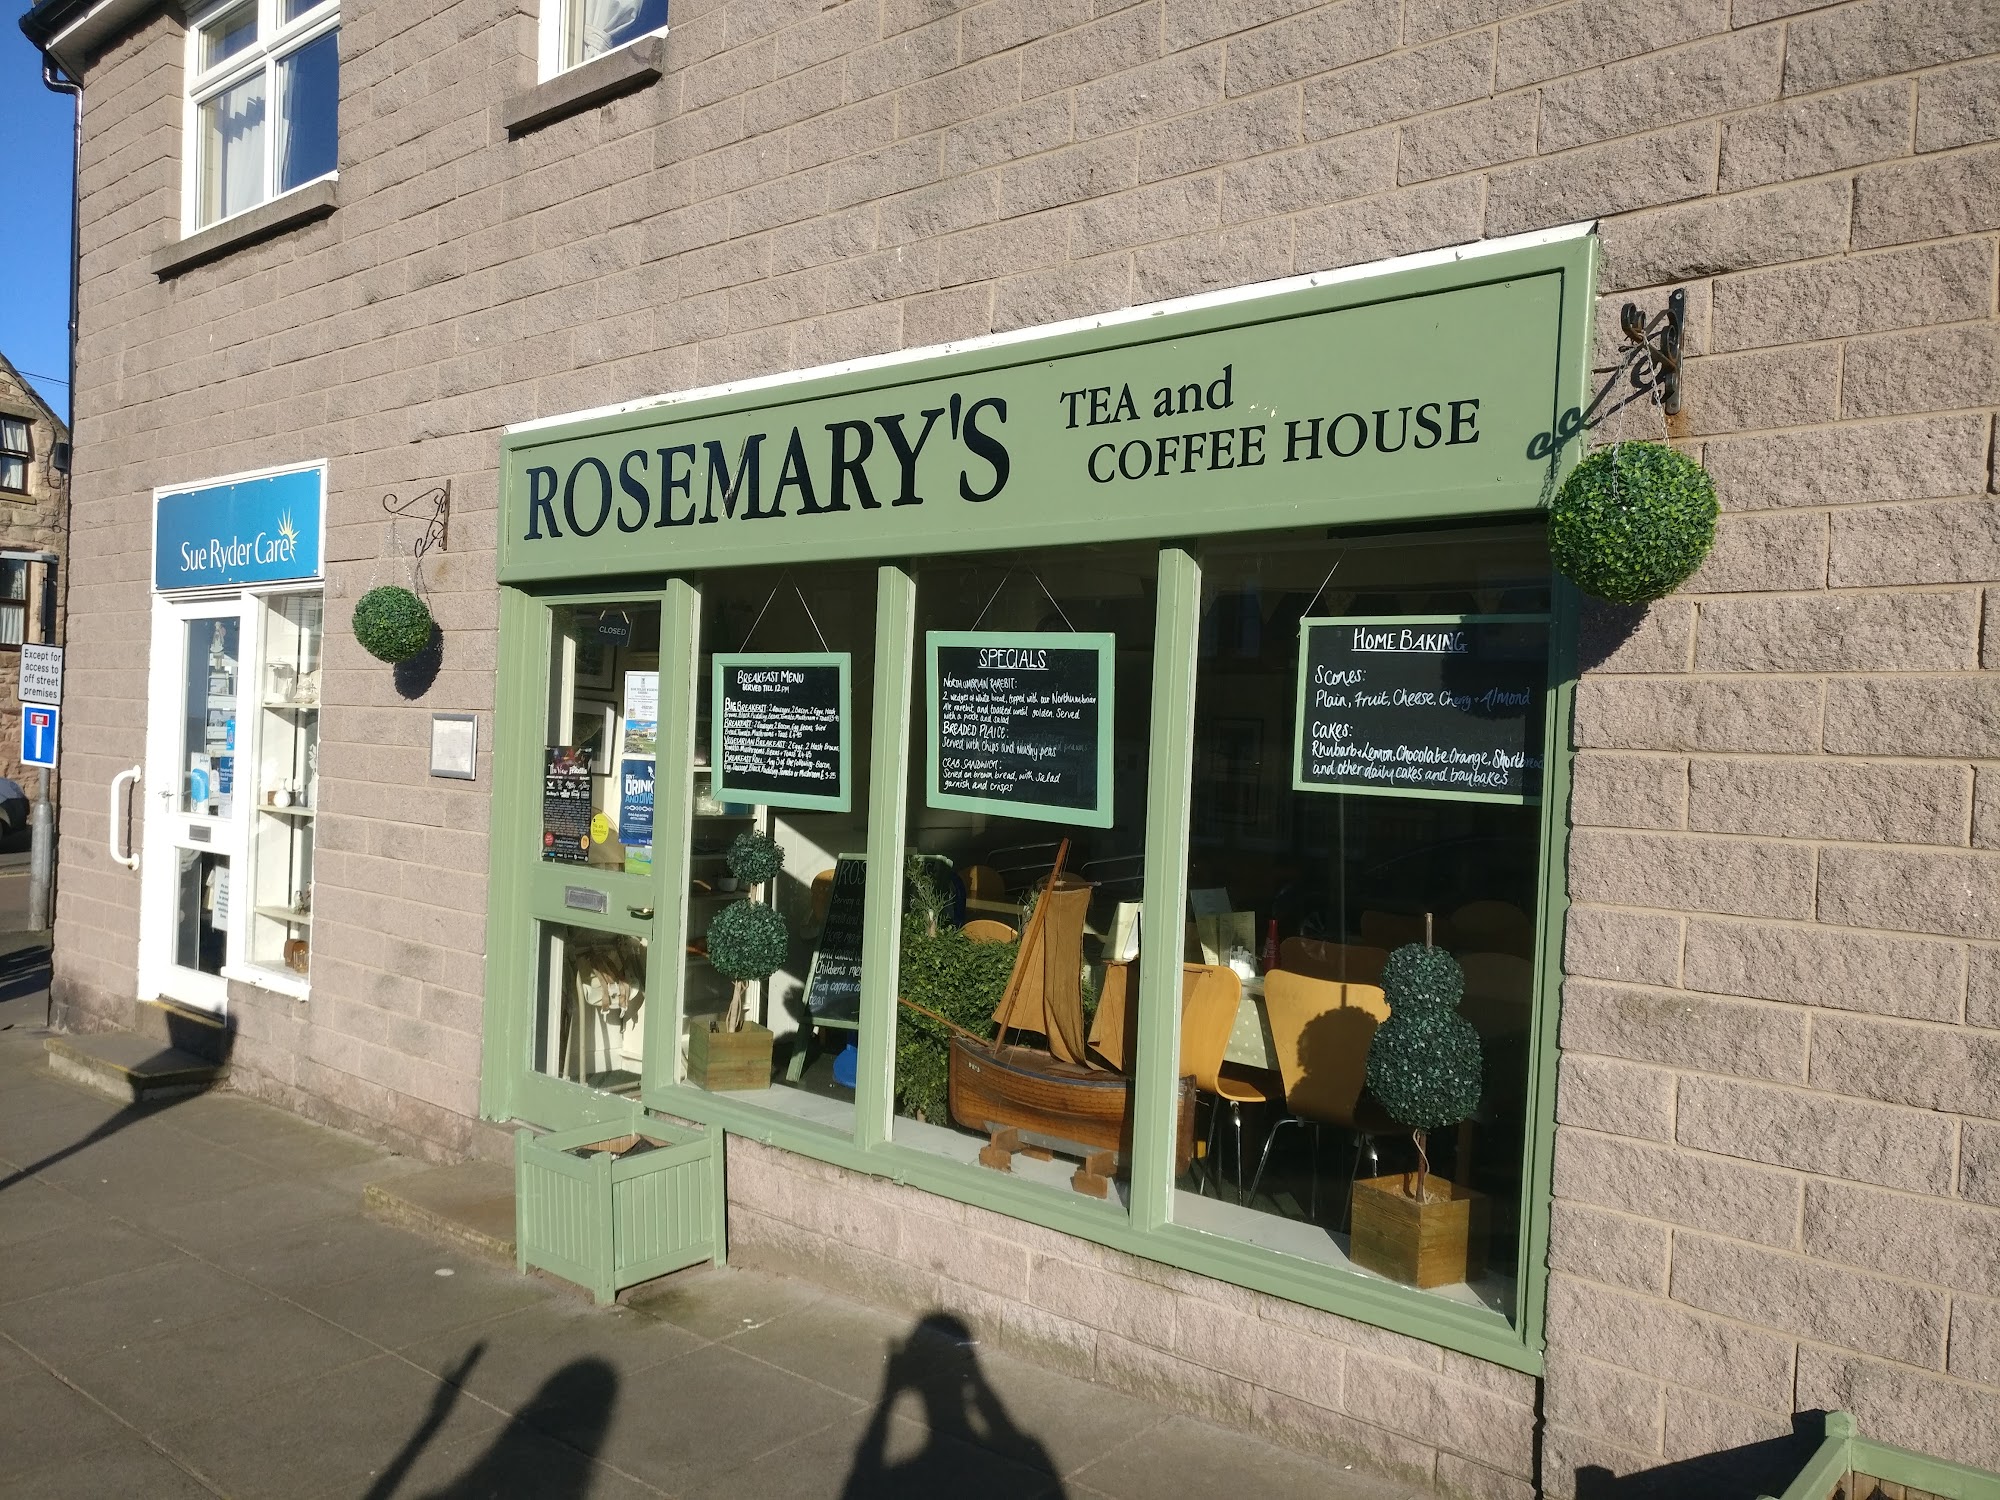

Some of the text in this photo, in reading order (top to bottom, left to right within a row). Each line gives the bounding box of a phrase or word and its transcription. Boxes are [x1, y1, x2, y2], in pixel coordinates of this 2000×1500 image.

[1059, 363, 1234, 429] TEA and
[1087, 398, 1481, 484] COFFEE HOUSE
[524, 392, 1010, 541] ROSEMARY'S
[180, 532, 290, 573] Sue Ryder Care
[598, 625, 627, 636] CLOSED
[1353, 626, 1467, 651] HOME BAKING
[24, 648, 61, 662] Except for
[978, 648, 1048, 668] SPECIALS
[25, 663, 59, 674] access to
[737, 670, 804, 684] BREAKFAST MENU
[1315, 664, 1366, 686] Scones:
[24, 673, 58, 687] off street
[24, 687, 58, 699] premises
[1315, 689, 1351, 708] Plain,
[976, 705, 989, 715] and
[942, 720, 977, 737] BREADED
[1312, 721, 1353, 741] Cakes:
[1312, 741, 1357, 758] Rhubarb
[1396, 745, 1447, 764] Chocolate
[1312, 760, 1335, 775] and
[1337, 762, 1362, 776] other
[1364, 764, 1395, 785] daily
[1395, 765, 1423, 782] cakes
[1425, 767, 1448, 783] and
[625, 779, 654, 796] DRINK
[625, 792, 654, 804] AND DIVE
